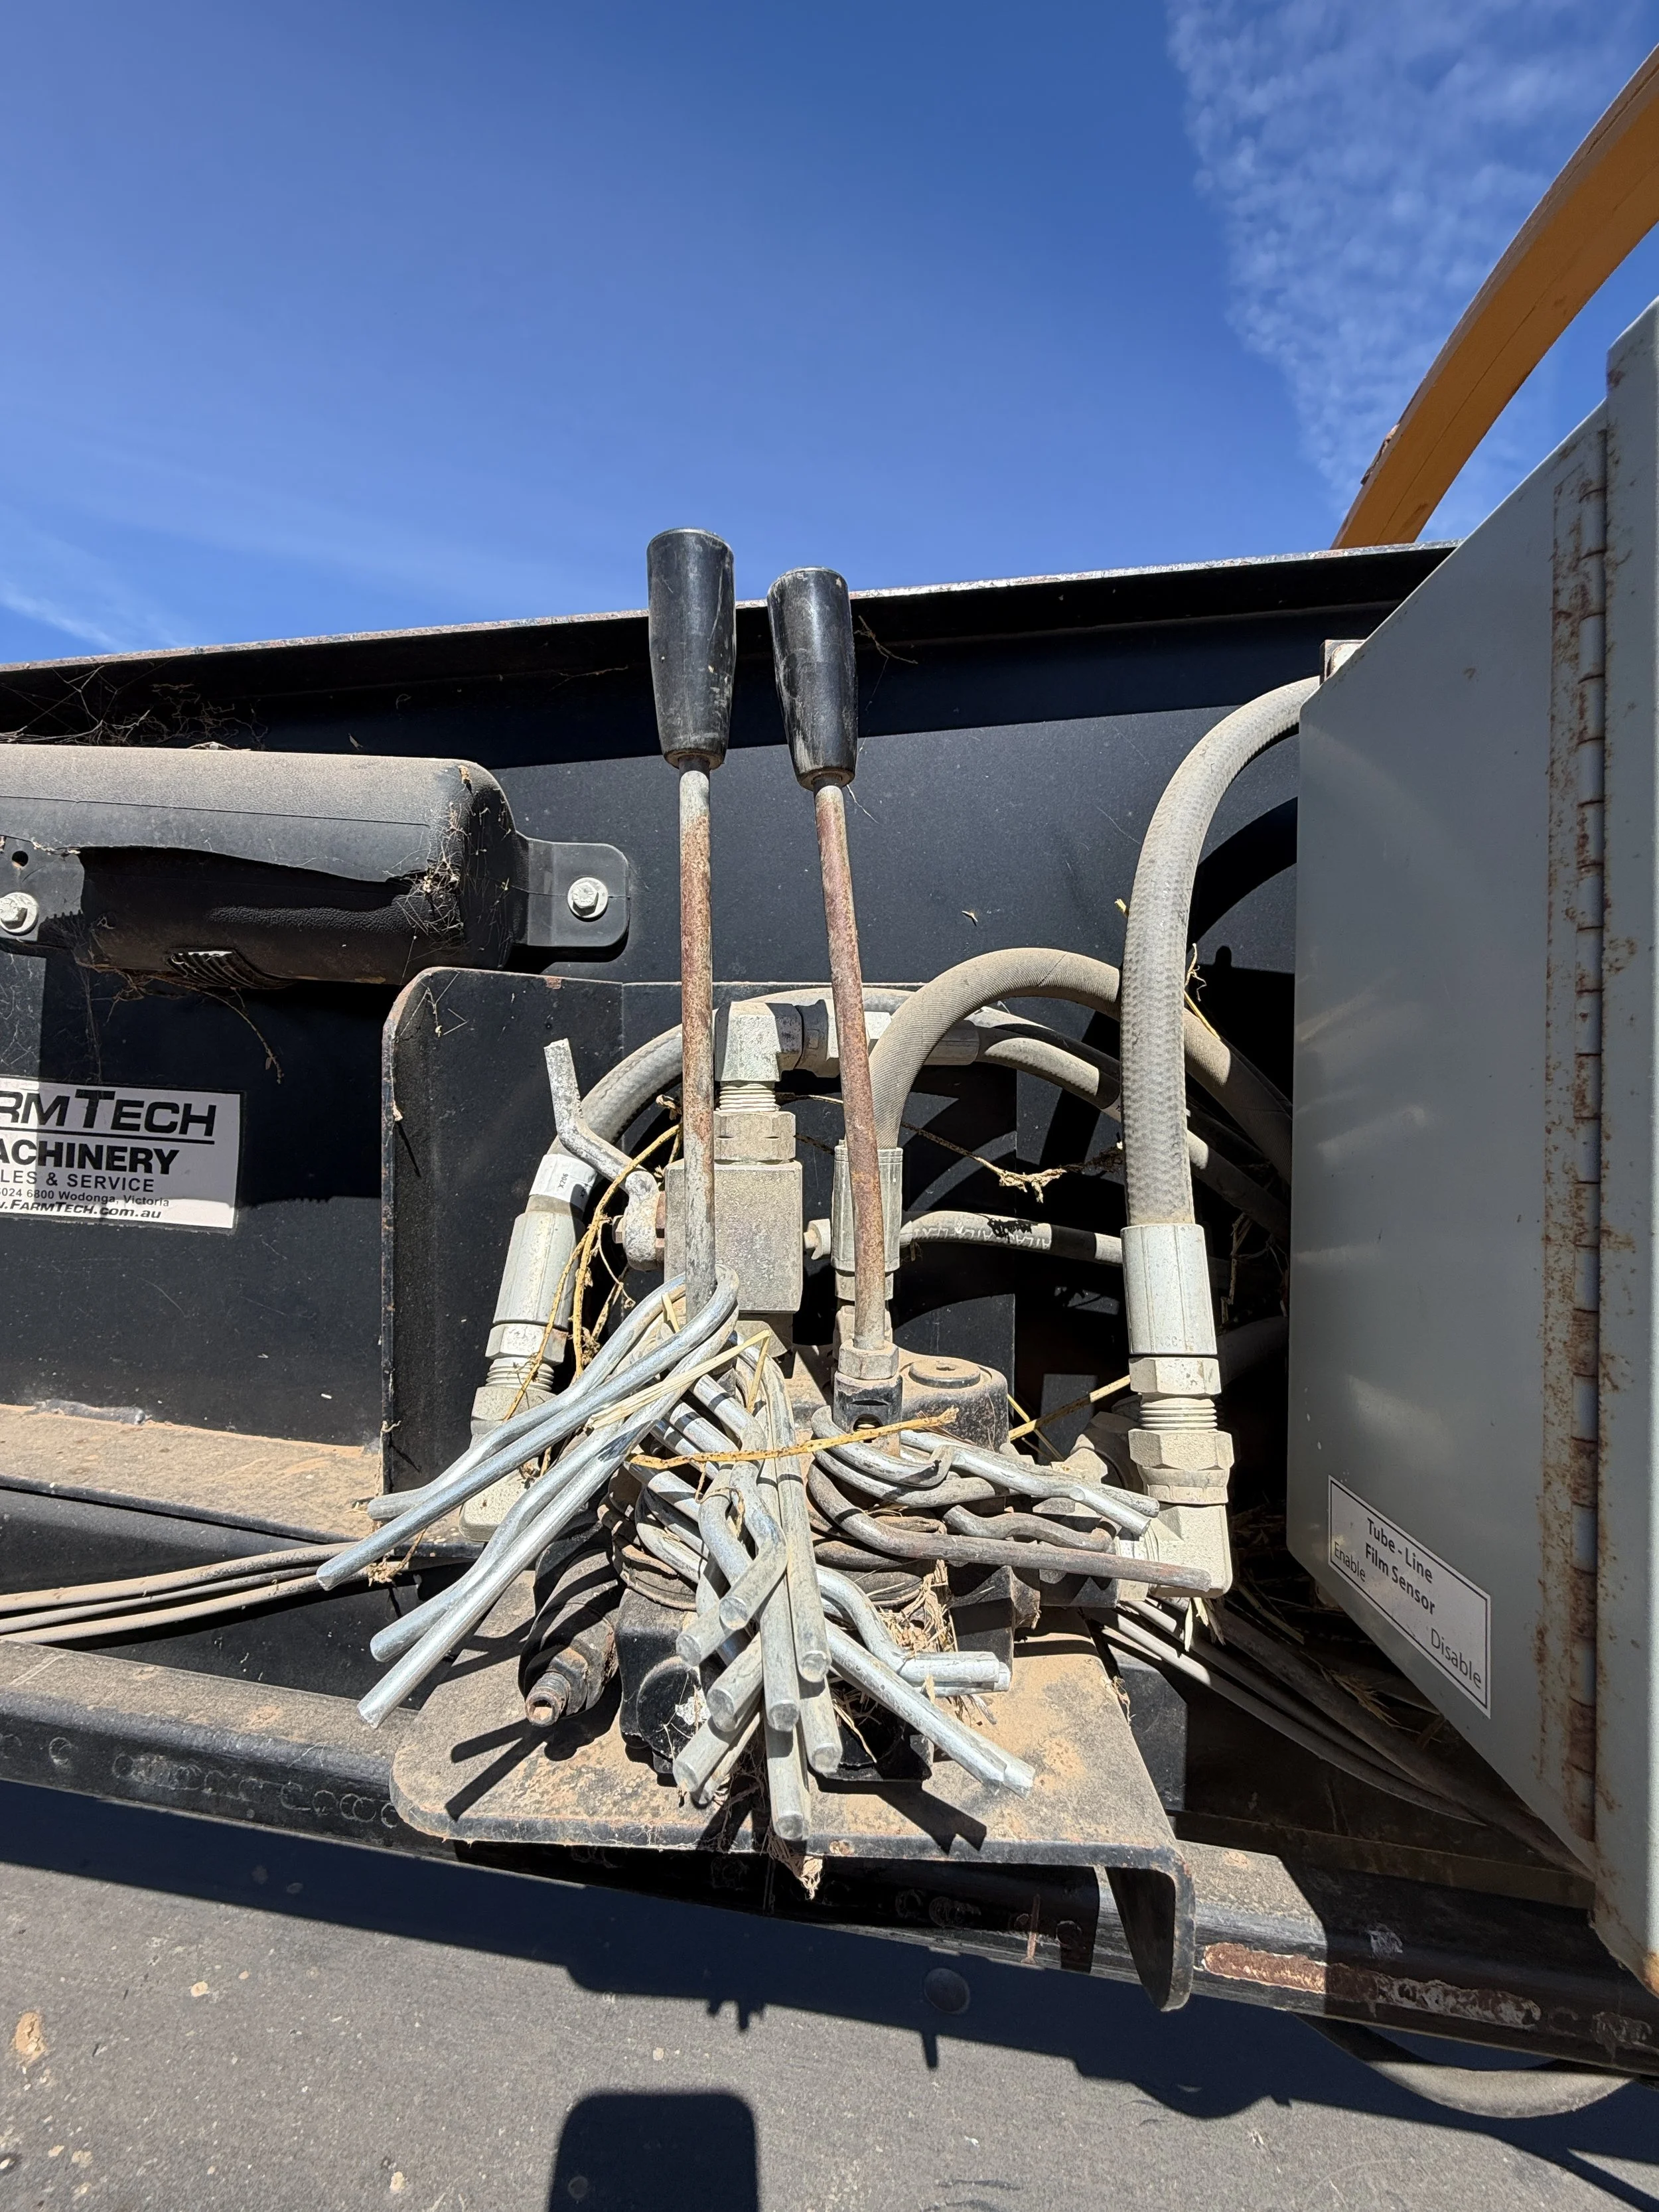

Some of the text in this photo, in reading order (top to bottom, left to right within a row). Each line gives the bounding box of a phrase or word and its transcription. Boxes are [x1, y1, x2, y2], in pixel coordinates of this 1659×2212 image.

[0, 1187, 169, 1207] 024 6800 Wodonga, Victoria
[46, 1172, 58, 1186] &
[67, 1173, 154, 1193] SERVICE
[557, 1173, 569, 1189] X206
[1334, 1541, 1366, 1582] Enable
[1367, 1517, 1396, 1554] Tube
[1405, 1547, 1433, 1584] Line
[1366, 1542, 1435, 1615] Film Sensor
[1431, 1627, 1482, 1690] Disable
